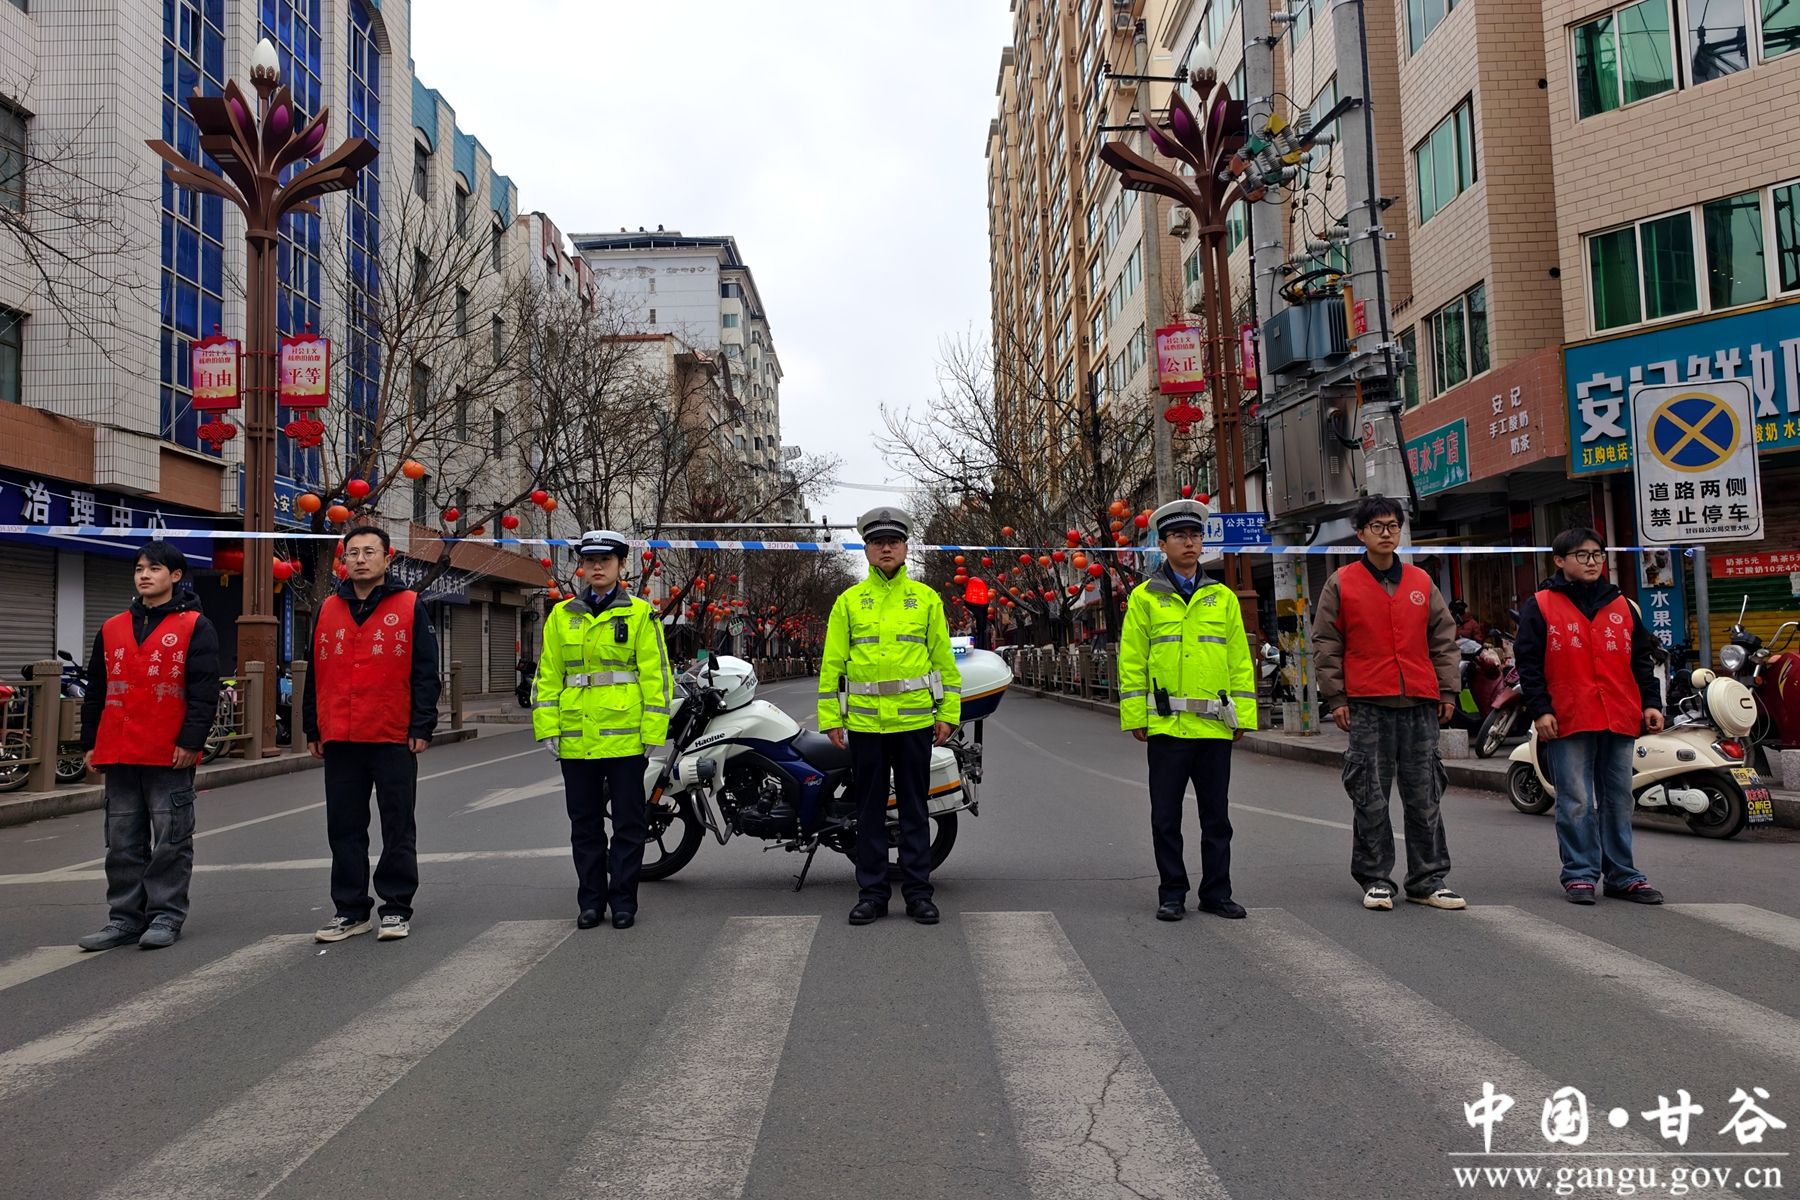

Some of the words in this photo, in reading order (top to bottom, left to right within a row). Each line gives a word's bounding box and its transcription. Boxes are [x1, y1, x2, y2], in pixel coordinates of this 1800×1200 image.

[1167, 356, 1198, 372] 公正
[201, 369, 231, 387] 自由
[289, 368, 320, 384] 平等
[1492, 386, 1522, 416] 安记
[1490, 410, 1529, 438] 手工酸奶
[1511, 434, 1530, 455] 奶茶
[1648, 477, 1747, 502] 道路两侧
[0, 480, 167, 541] 治理中心
[1650, 503, 1749, 527] 禁止停车
[1685, 525, 1750, 535] 甘谷县公安局交警大队
[1725, 556, 1760, 567] 奶茶5元
[320, 628, 345, 643] 文明
[373, 629, 408, 643] 交通
[150, 650, 185, 664] 交通
[371, 643, 406, 657] 服务
[147, 665, 181, 678] 服务
